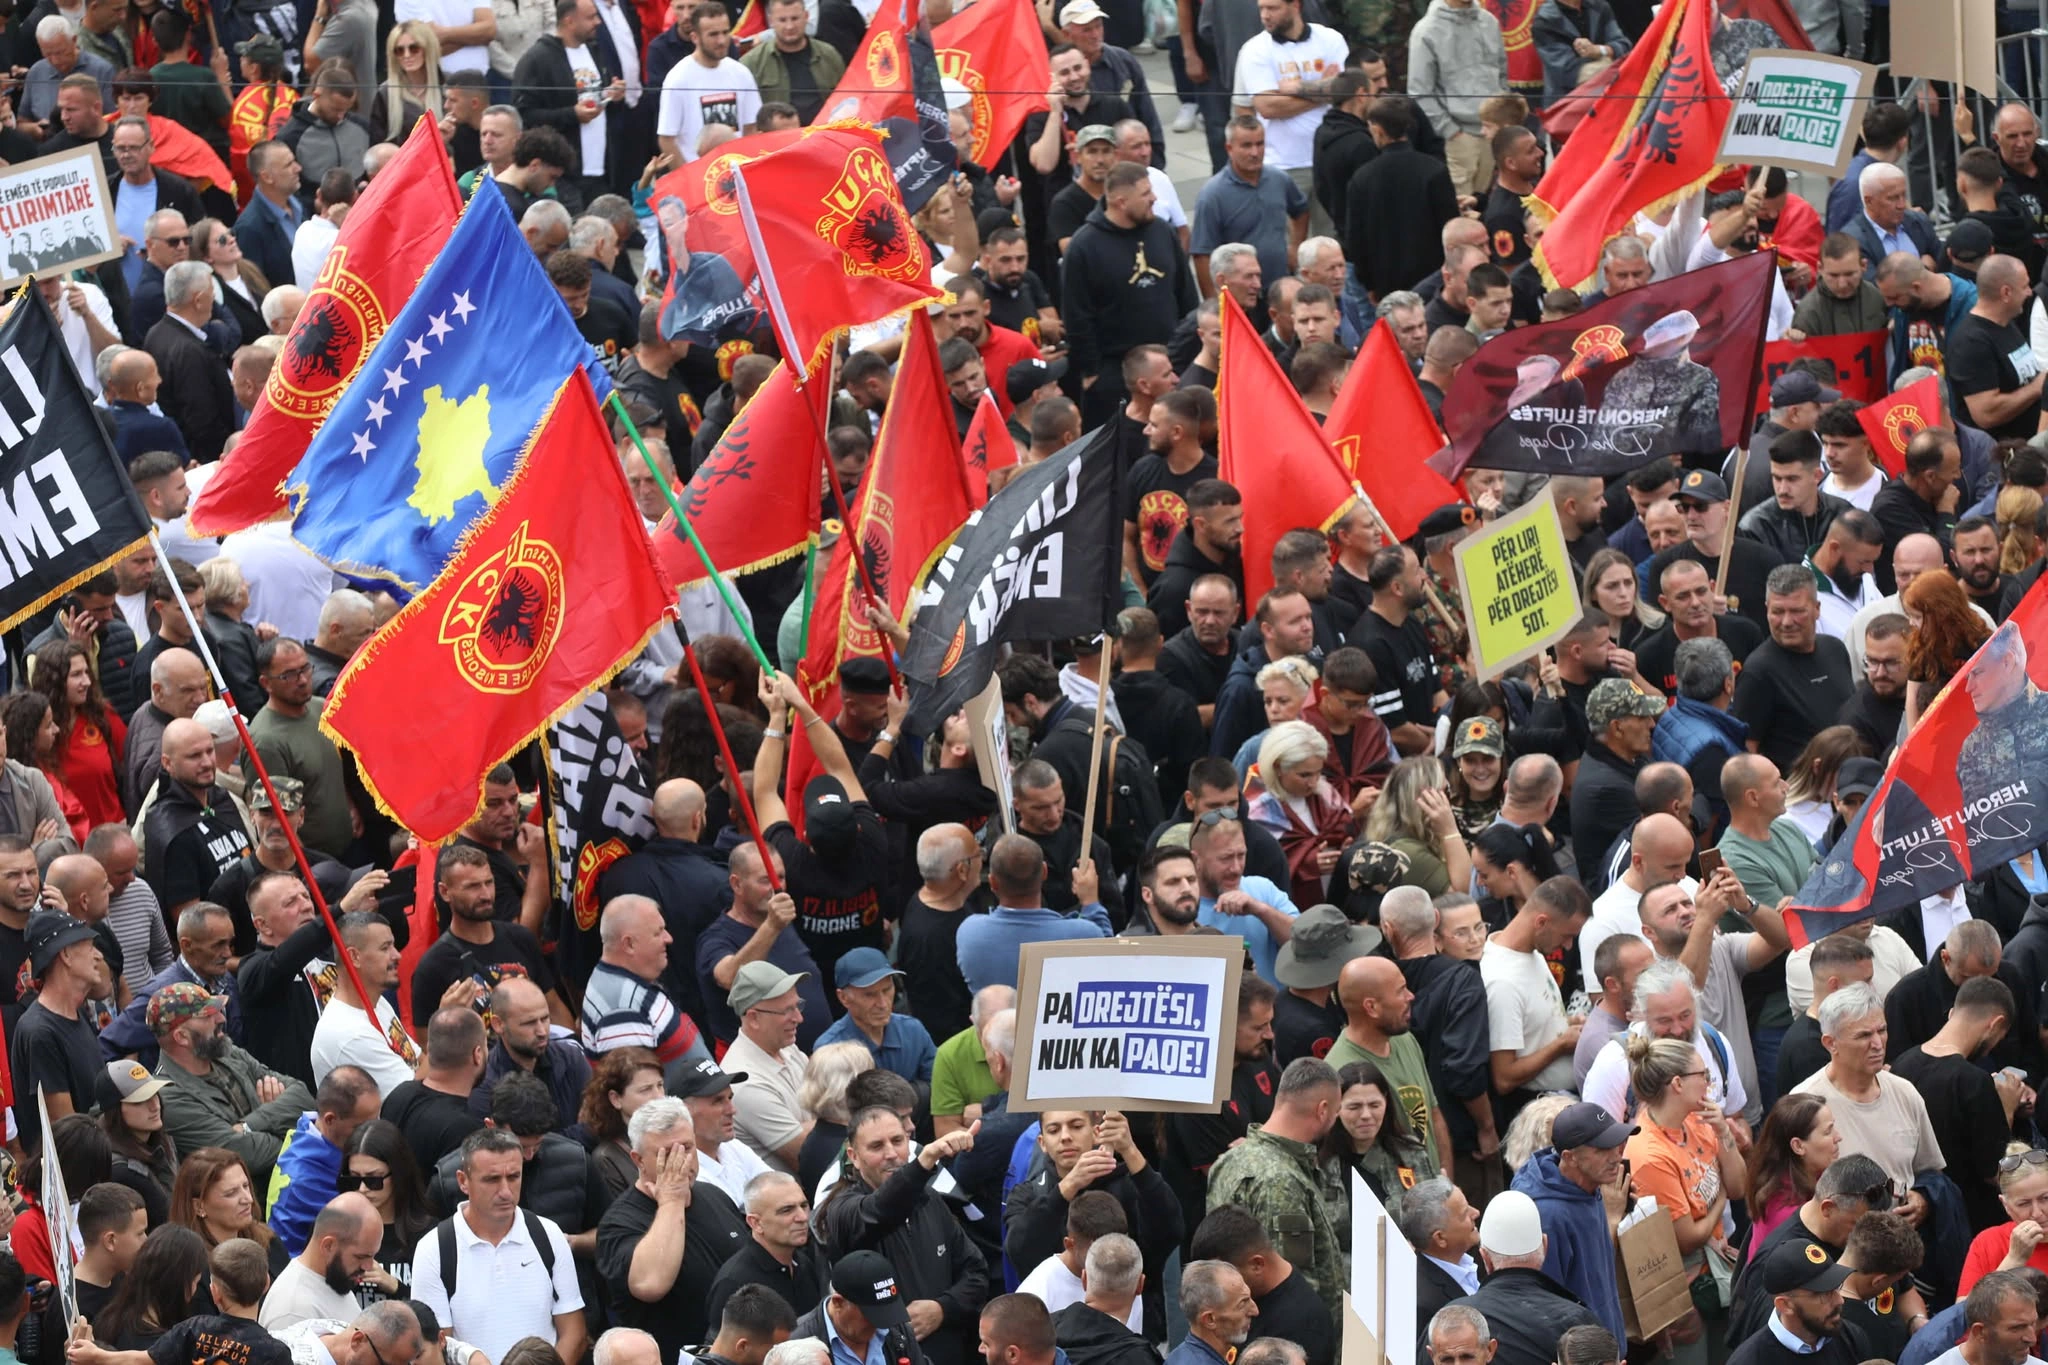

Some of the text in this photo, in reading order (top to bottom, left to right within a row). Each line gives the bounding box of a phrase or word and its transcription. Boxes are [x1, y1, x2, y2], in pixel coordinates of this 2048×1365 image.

[1741, 82, 1760, 104] PA
[1732, 113, 1836, 145] NUK KA PAQE!
[4, 183, 33, 202] EMËR
[31, 178, 43, 195] TË
[42, 170, 80, 191] POPULLIT
[0, 177, 94, 239] ÇLIRIMTARË
[1491, 525, 1540, 566] PËR LIRI
[1487, 595, 1513, 626] PËR
[1521, 607, 1550, 637] SOT.
[1043, 984, 1202, 1030] PA DREJTËSI,
[1038, 1037, 1205, 1075] NUK KA PAQE!
